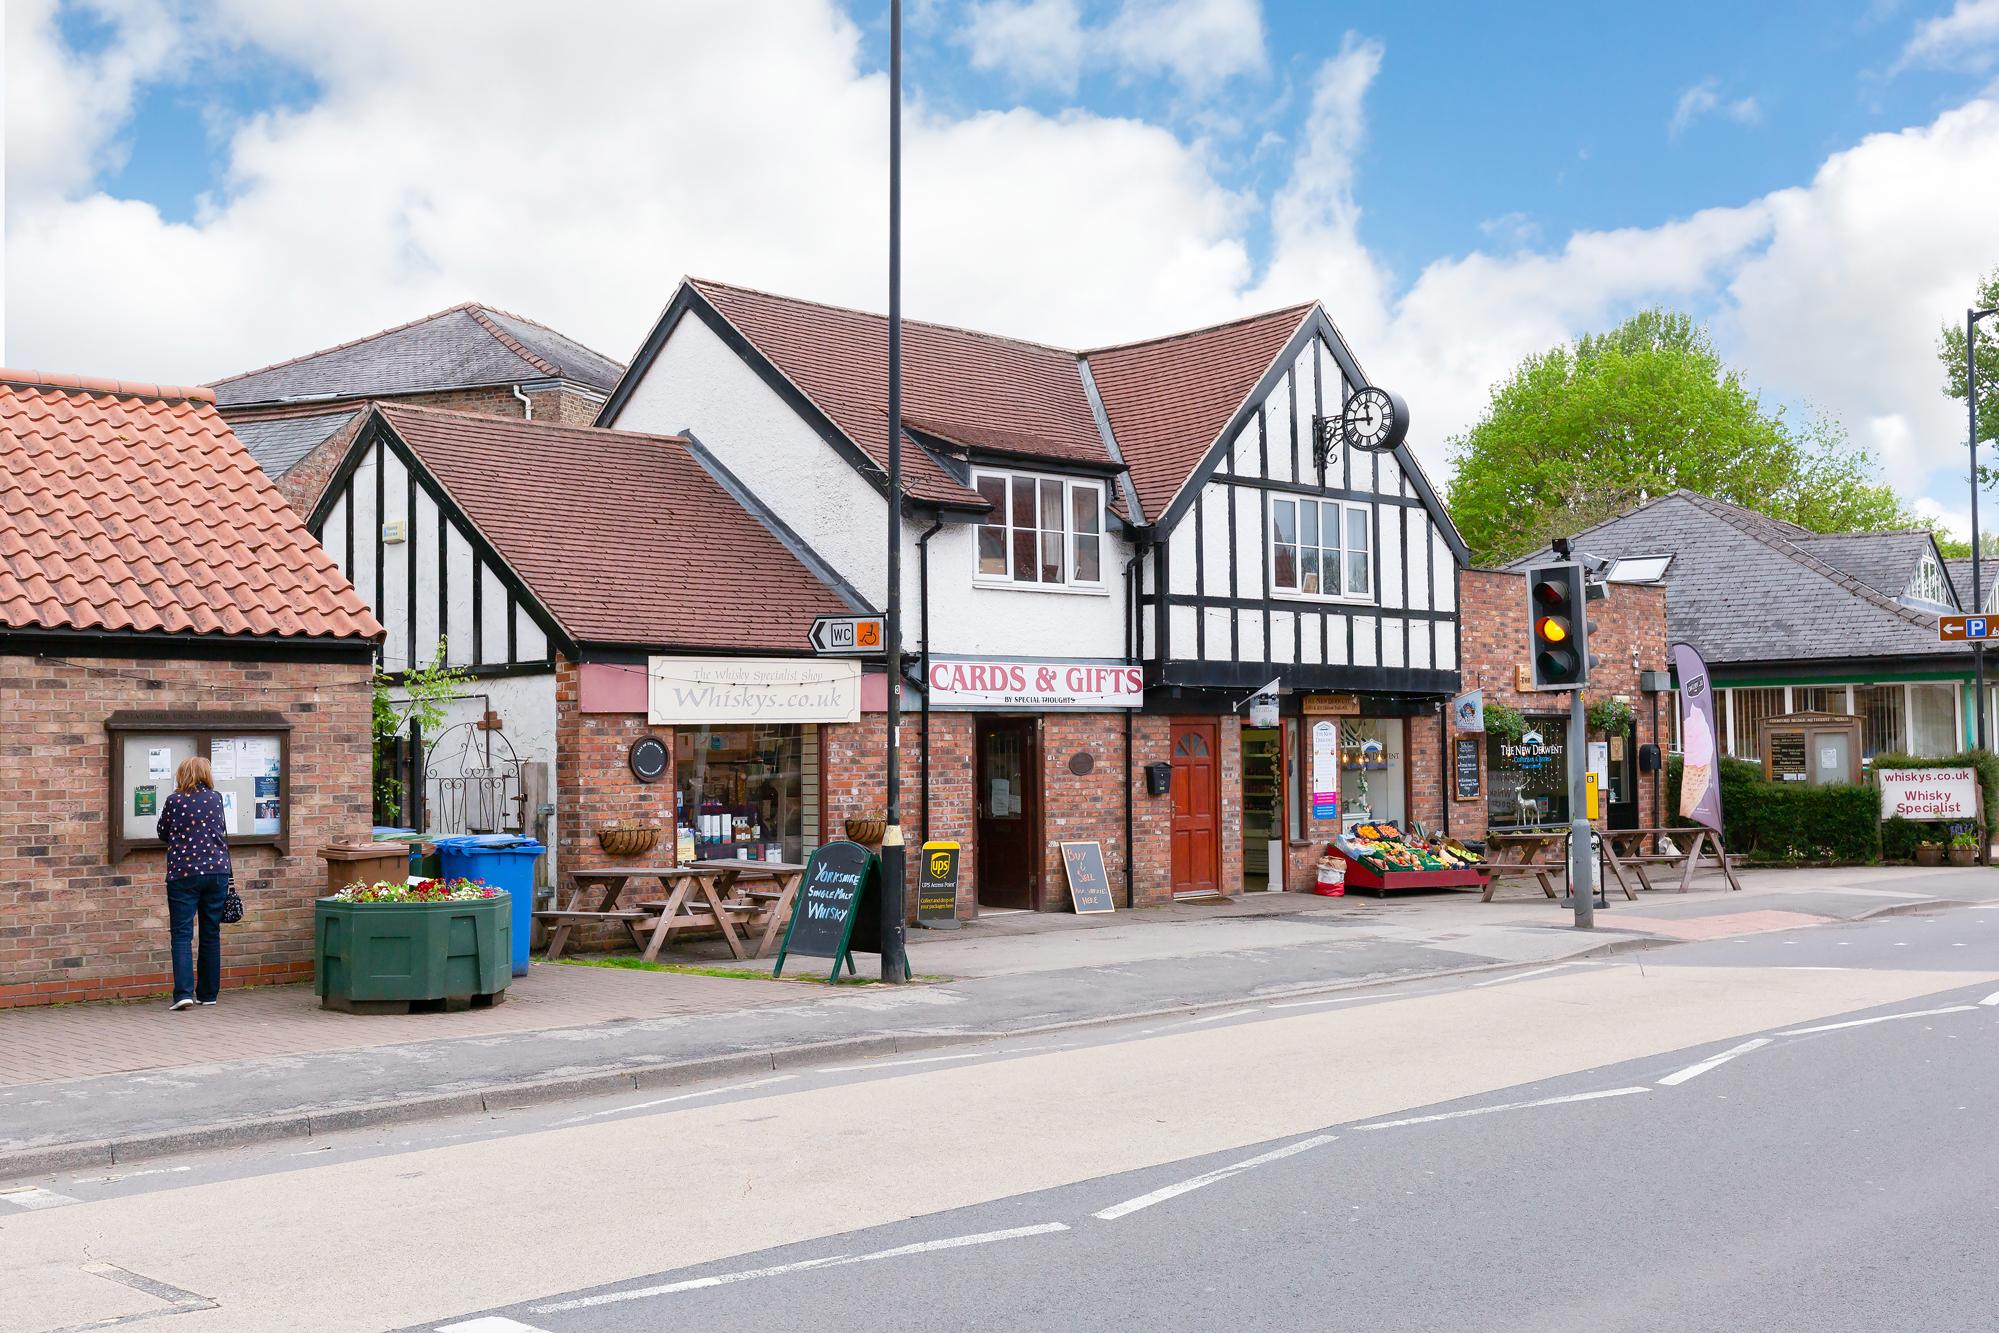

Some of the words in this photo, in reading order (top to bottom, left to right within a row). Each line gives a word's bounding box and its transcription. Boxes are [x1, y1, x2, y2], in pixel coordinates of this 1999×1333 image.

[833, 628, 851, 642] WC
[1970, 620, 1984, 636] P
[693, 667, 710, 681] The
[715, 667, 750, 682] Whisky
[753, 667, 798, 682] Specialist
[801, 668, 823, 682] Shop
[929, 663, 1027, 692] CARDS
[1035, 666, 1057, 692] &
[1065, 667, 1143, 694] GIFTS
[672, 683, 841, 715] Whiskys.co.uk
[1501, 744, 1514, 756] THE
[1515, 744, 1532, 756] NEW
[1532, 744, 1563, 756] DERWENT
[1884, 770, 1970, 783] whiskys.co.uk
[1904, 790, 1952, 802] Whisky
[1896, 802, 1961, 815] Specialist
[815, 862, 860, 885] YORKSHIRE
[932, 860, 949, 875] ups
[808, 885, 835, 899] SINGLE
[834, 887, 854, 900] MALT
[807, 900, 848, 922] WHISKY
